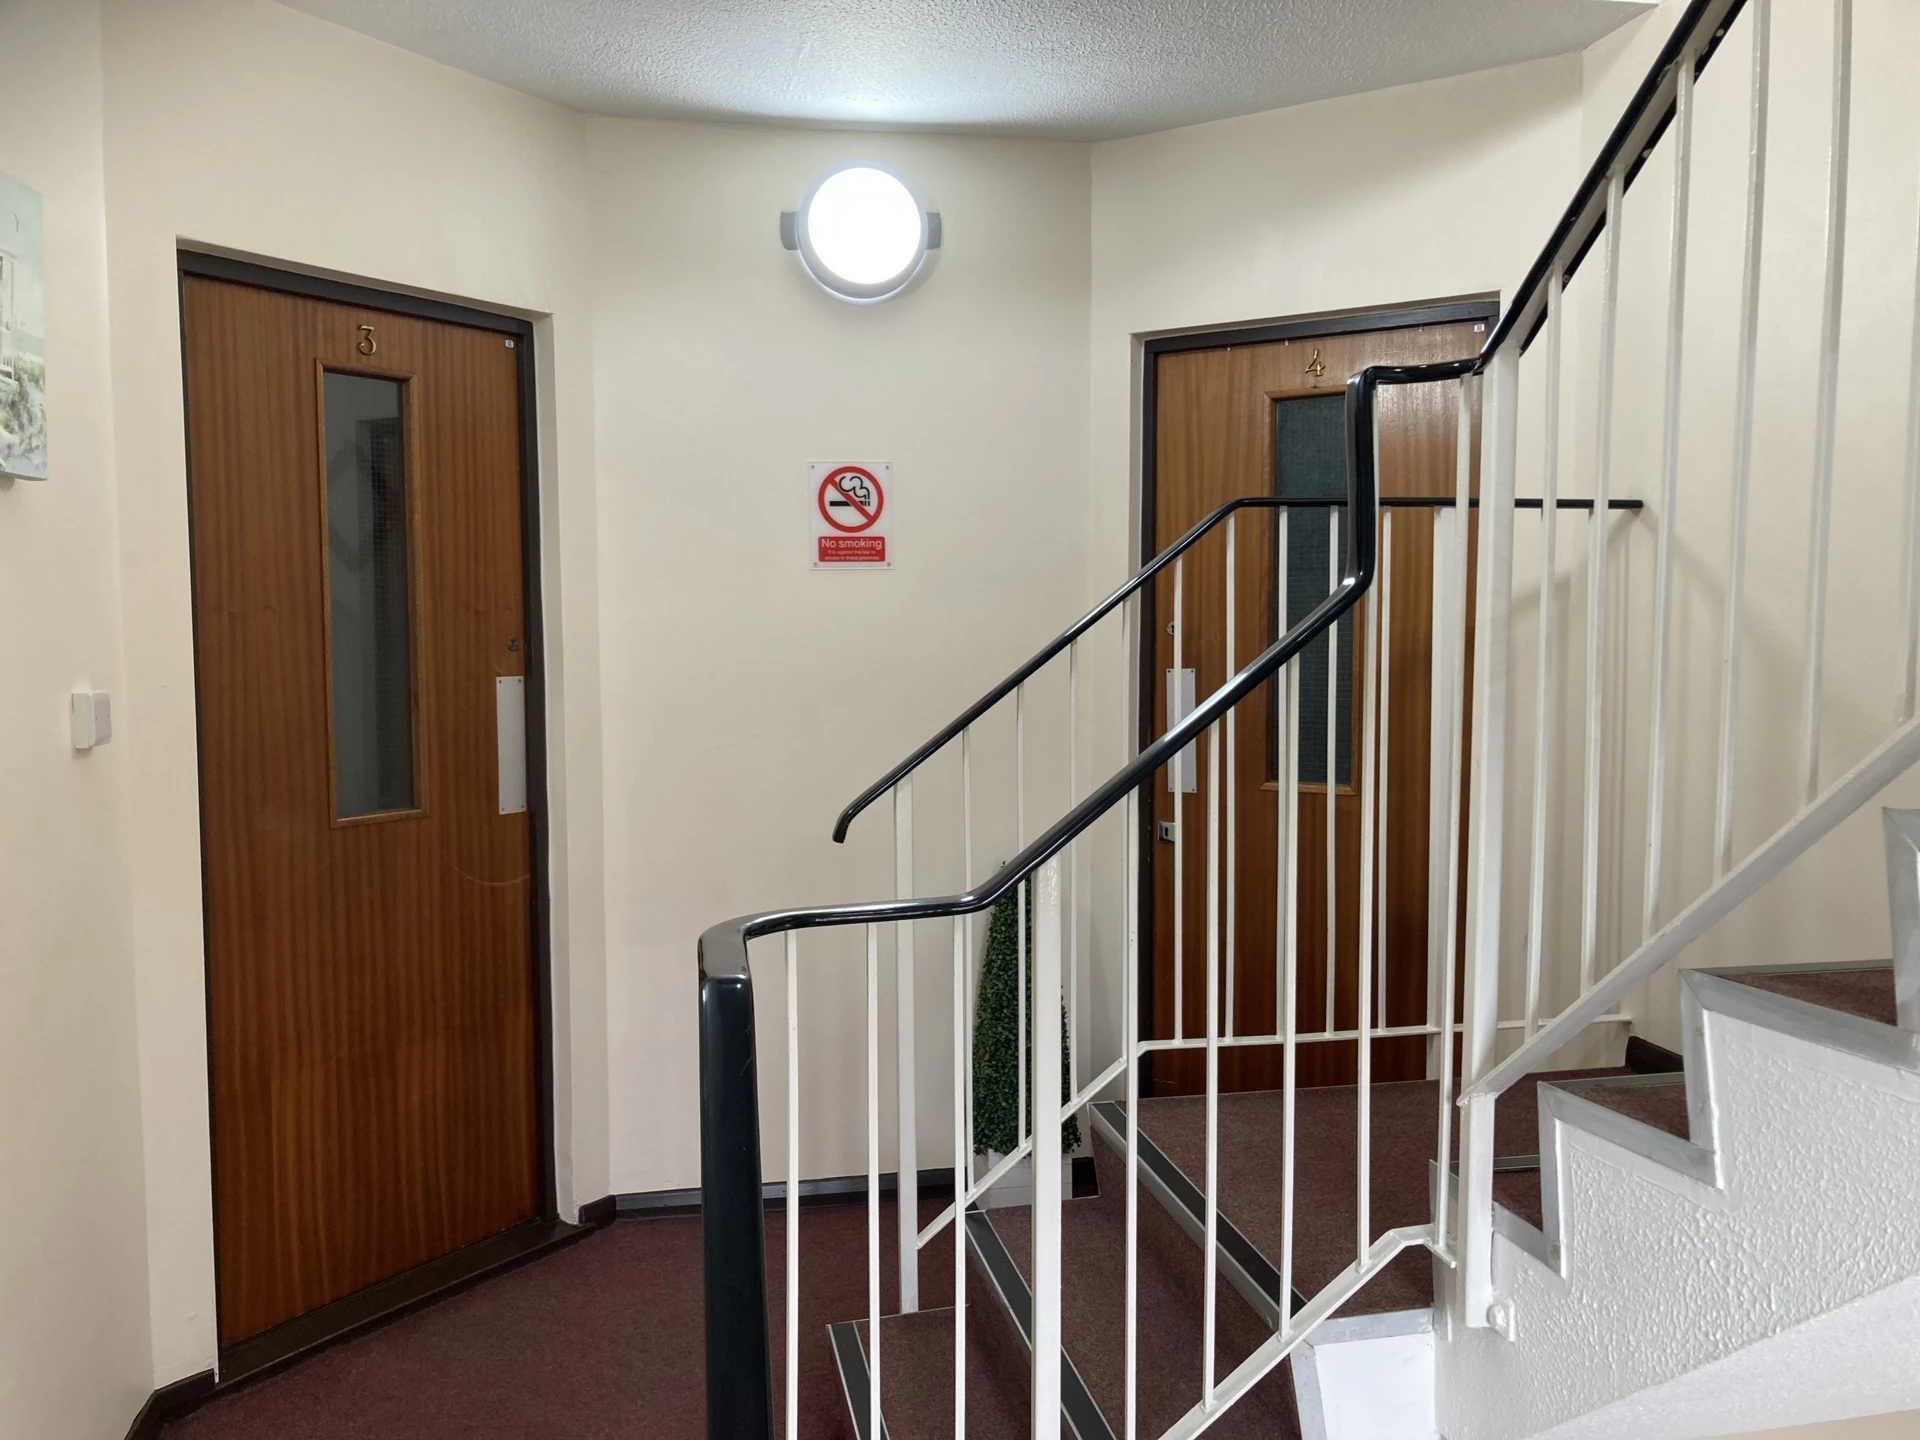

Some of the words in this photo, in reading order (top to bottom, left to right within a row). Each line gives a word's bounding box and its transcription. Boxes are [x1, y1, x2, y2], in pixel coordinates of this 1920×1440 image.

[357, 324, 377, 356] 3
[1305, 348, 1326, 377] 4
[821, 538, 836, 548] No
[838, 538, 882, 550] smoking
